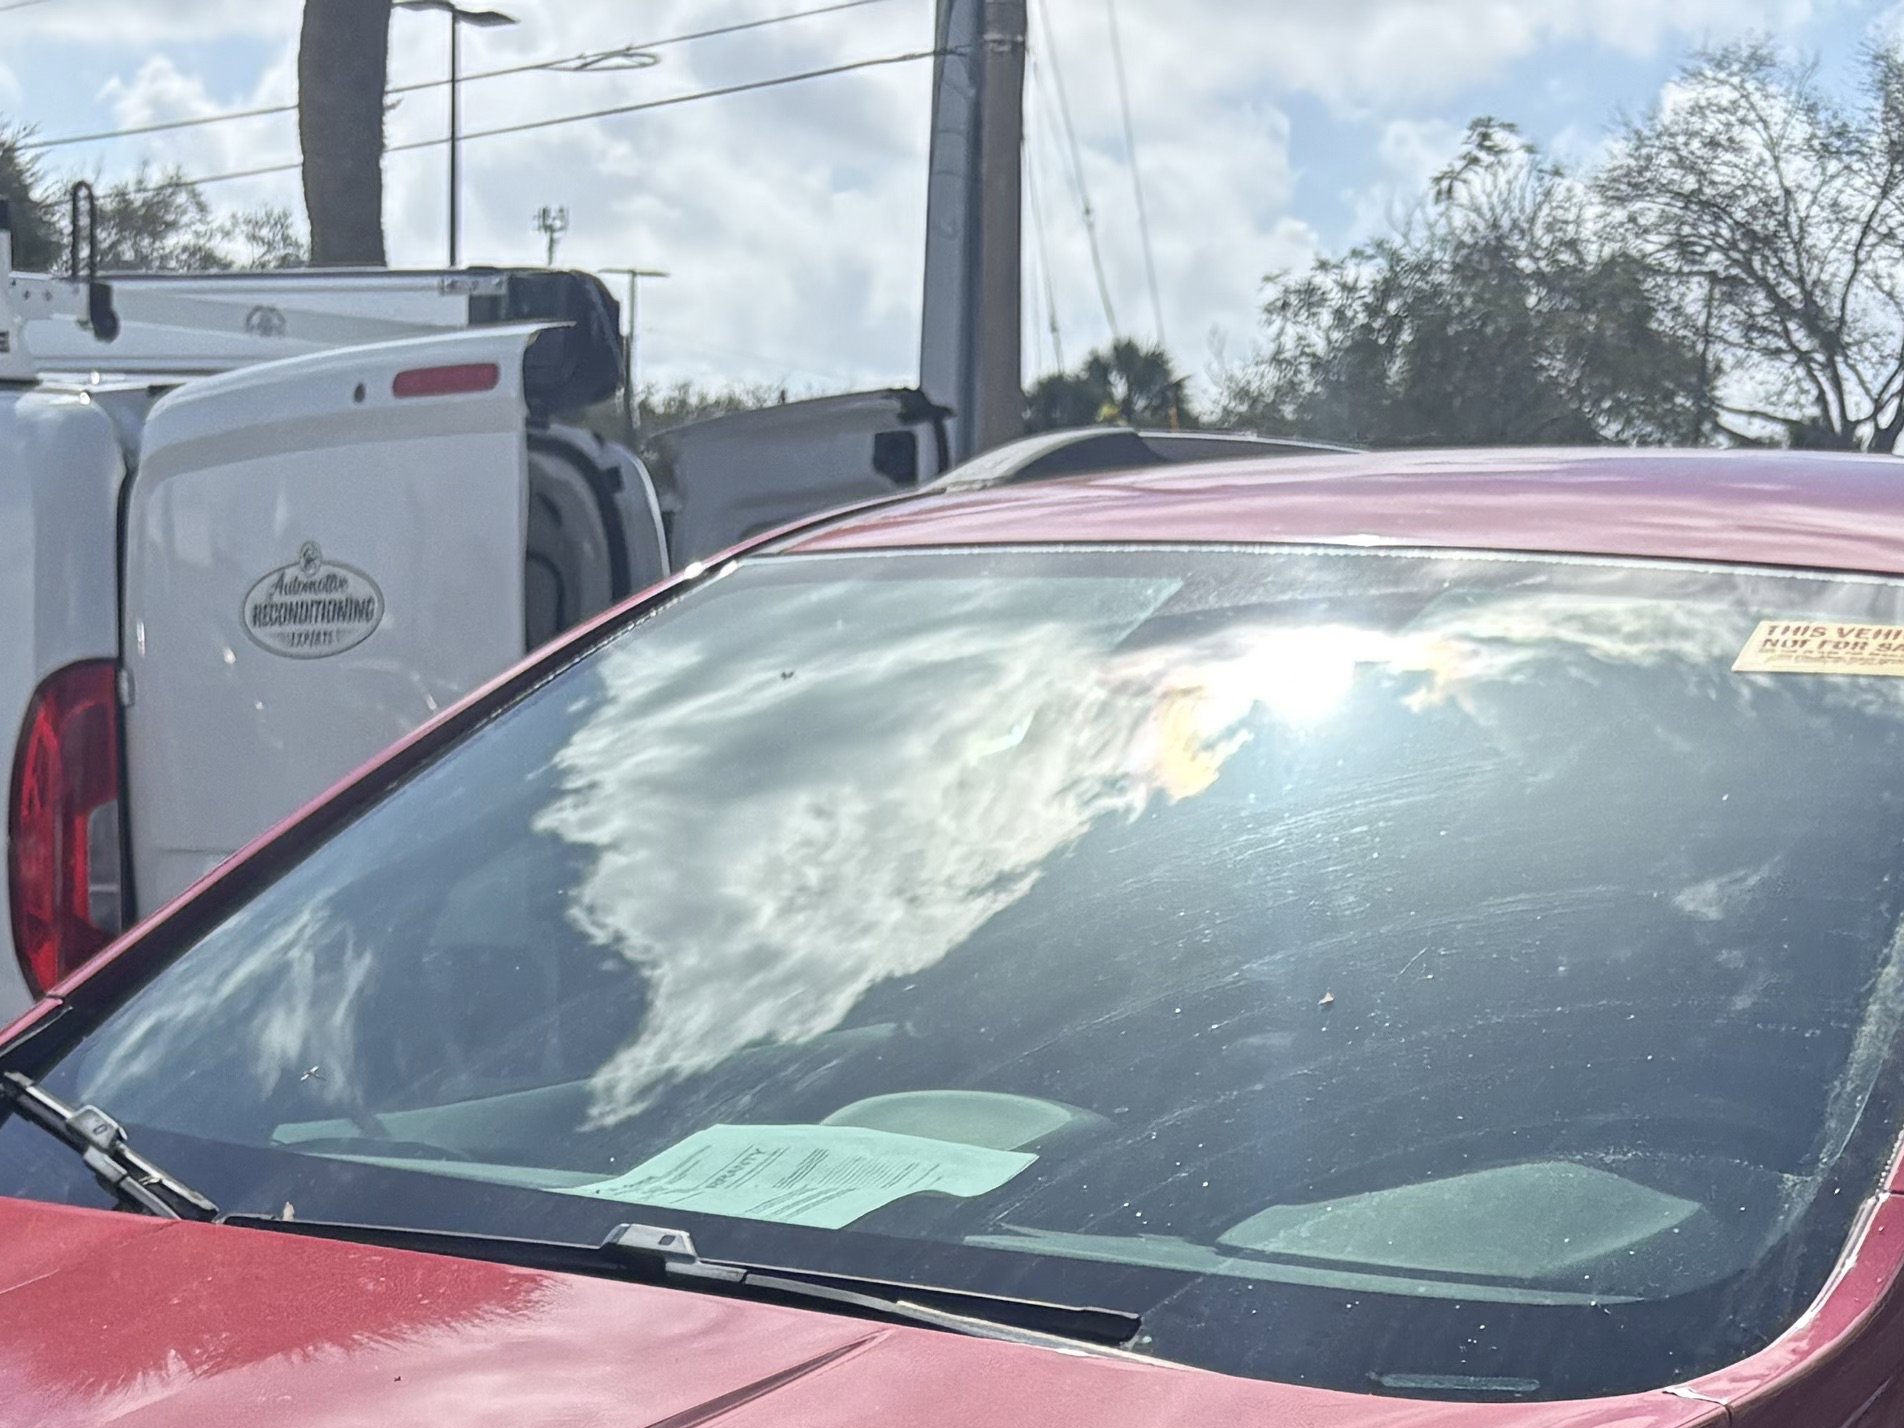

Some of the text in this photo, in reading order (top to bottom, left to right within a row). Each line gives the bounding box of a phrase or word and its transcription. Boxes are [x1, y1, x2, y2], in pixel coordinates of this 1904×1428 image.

[253, 597, 375, 627] RECONDITIONING
[1766, 625, 1828, 638] THIS
[1762, 638, 1814, 649] NOT
[1817, 640, 1869, 651] FOR
